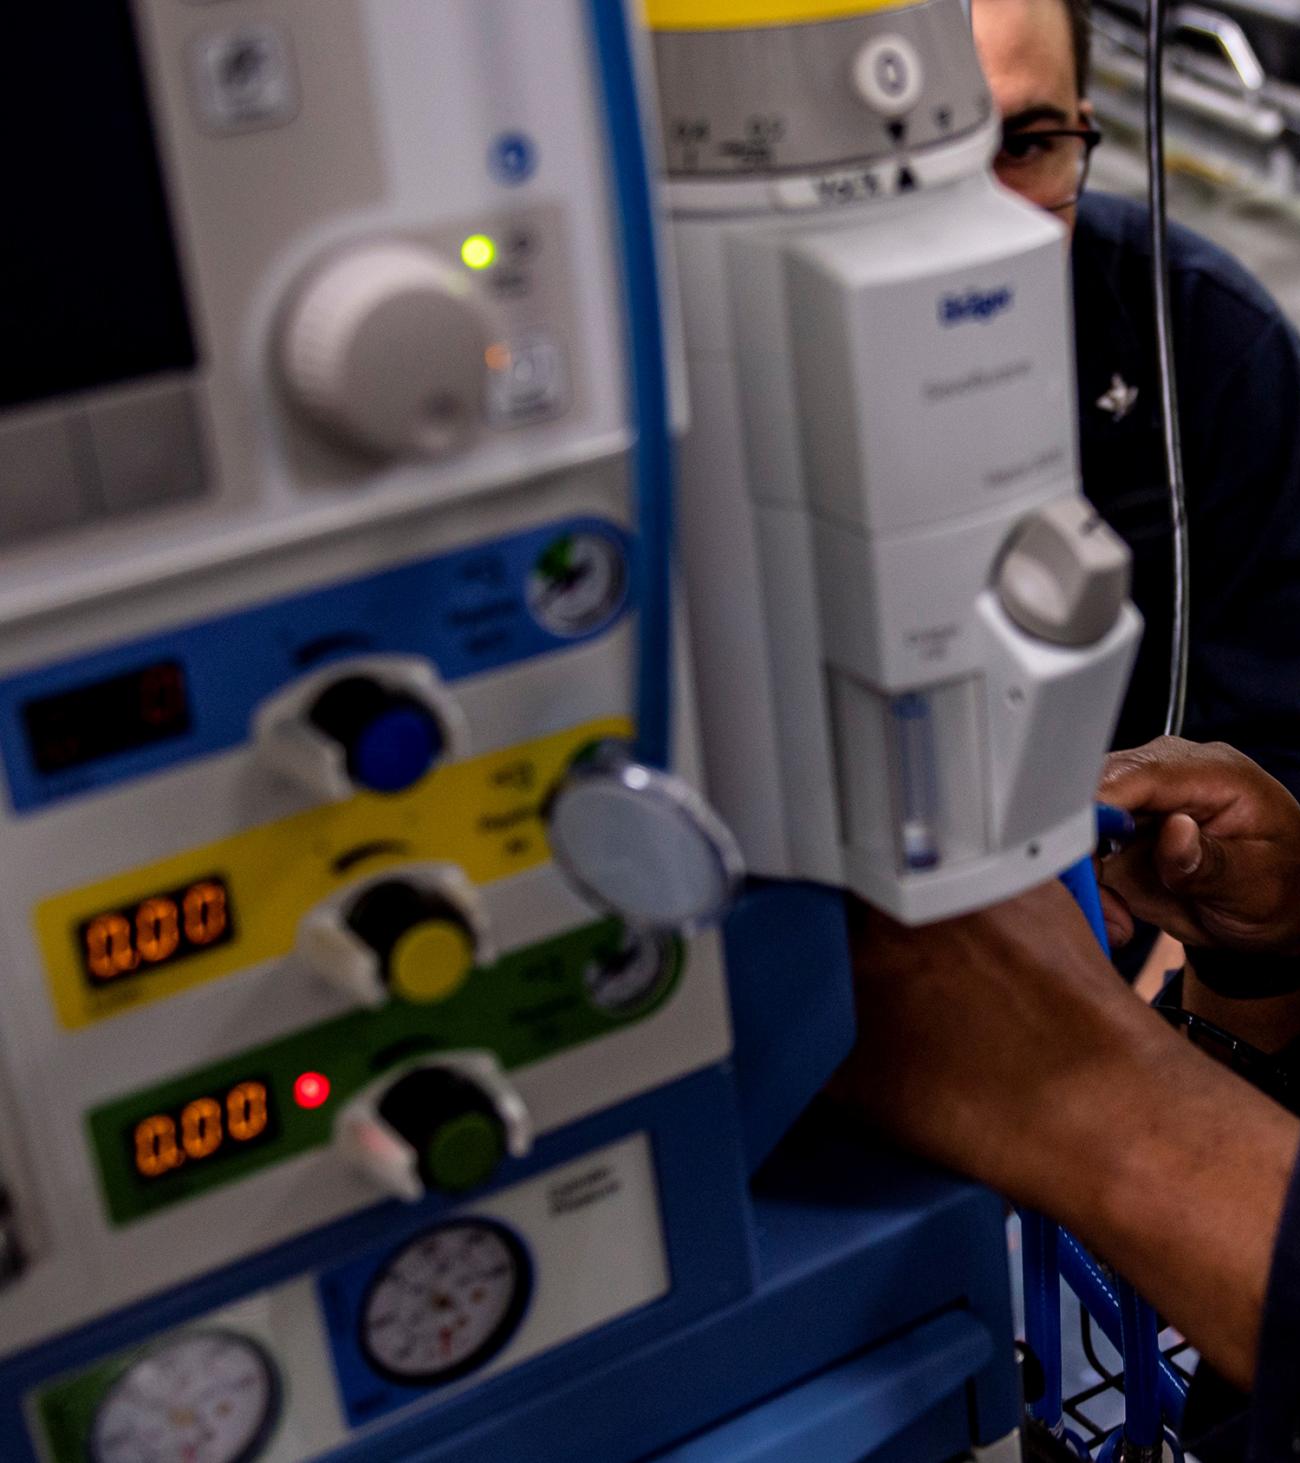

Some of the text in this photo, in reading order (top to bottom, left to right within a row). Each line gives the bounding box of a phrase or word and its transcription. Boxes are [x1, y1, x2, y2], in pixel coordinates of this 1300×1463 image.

[877, 51, 906, 95] 0
[86, 882, 226, 978] 0.00
[135, 1081, 268, 1177] 0.00
